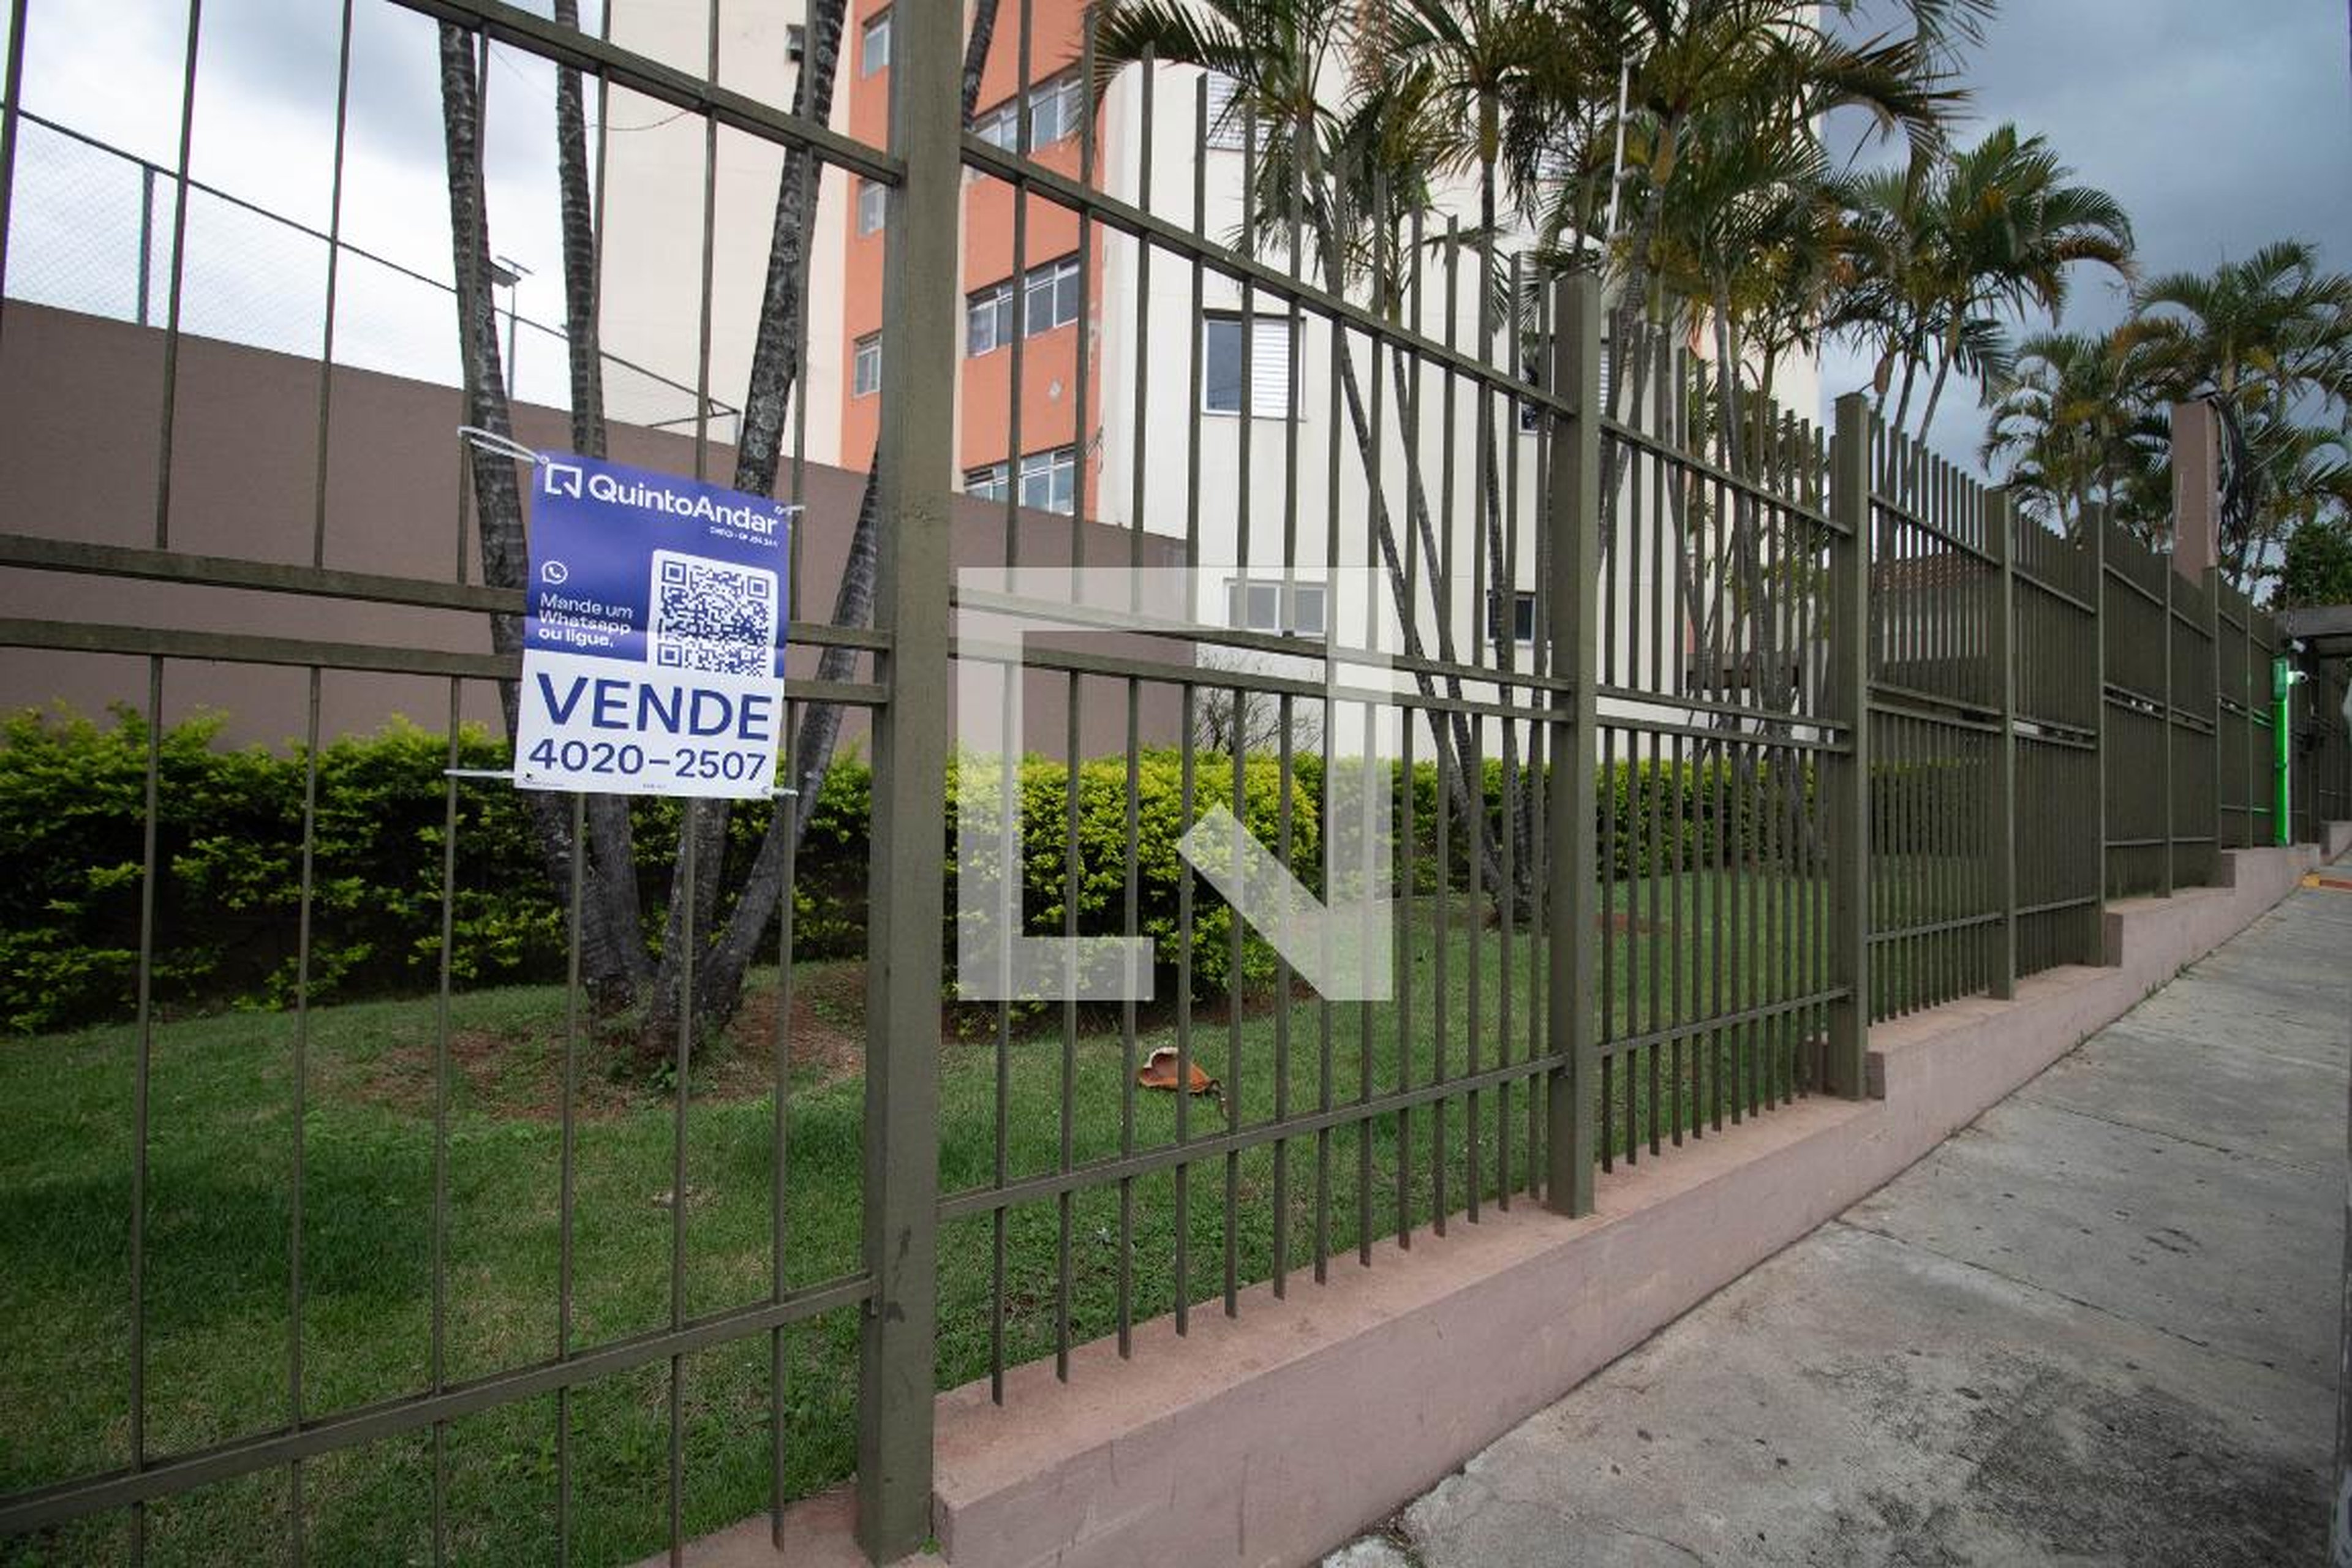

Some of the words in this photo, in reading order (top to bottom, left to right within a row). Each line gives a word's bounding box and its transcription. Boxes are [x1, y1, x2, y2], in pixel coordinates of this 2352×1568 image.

[588, 475, 777, 534] QuintoAndar
[539, 610, 631, 635] Whatsapp
[540, 592, 601, 614] Mande
[606, 605, 635, 619] um
[538, 628, 562, 639] ou
[537, 673, 772, 741] VENDE
[529, 739, 766, 780] 4020-2507
